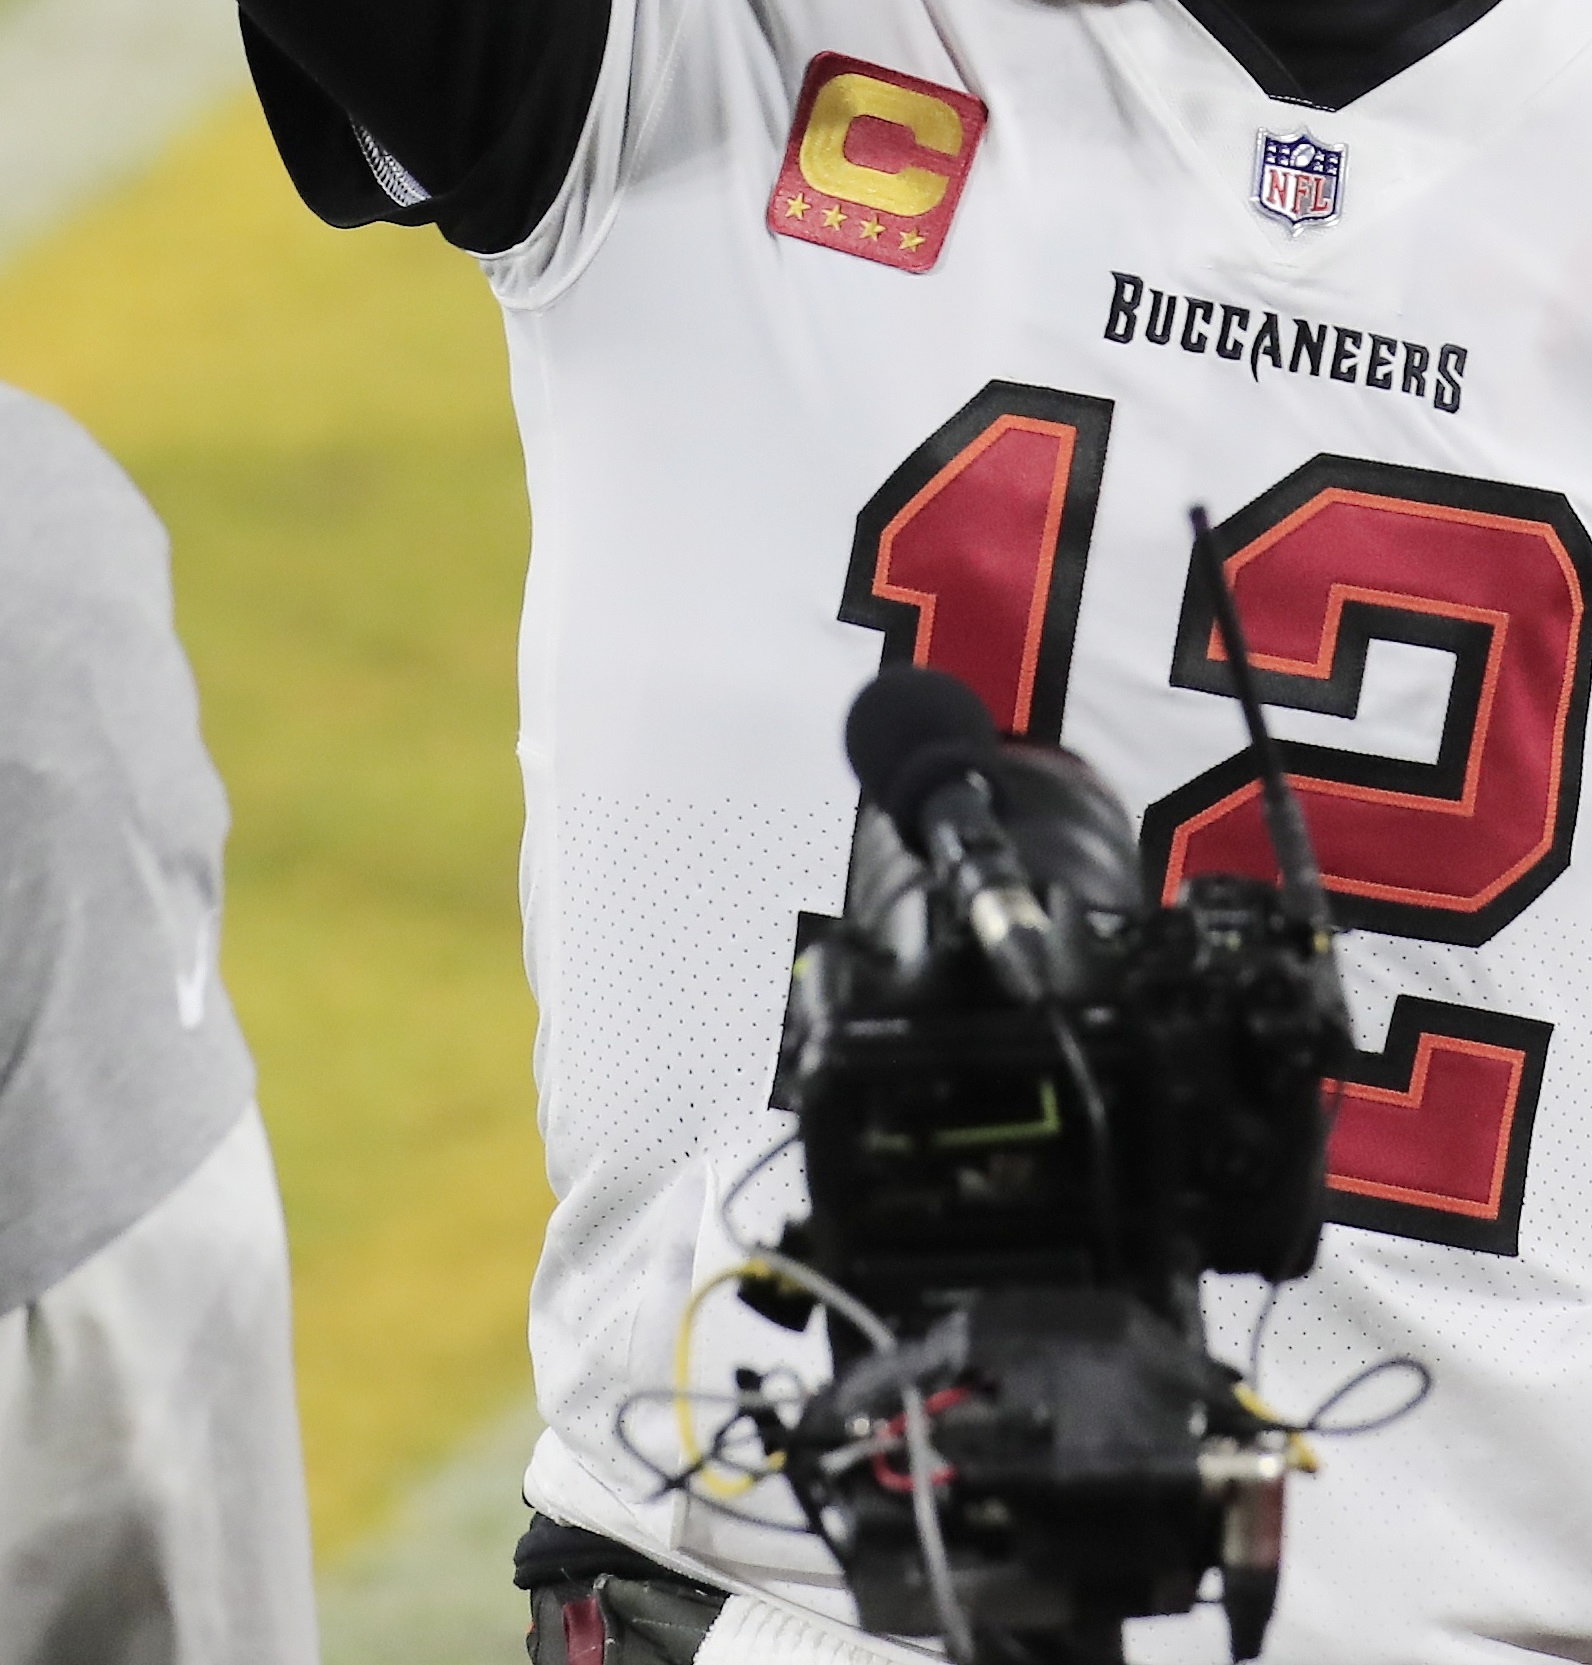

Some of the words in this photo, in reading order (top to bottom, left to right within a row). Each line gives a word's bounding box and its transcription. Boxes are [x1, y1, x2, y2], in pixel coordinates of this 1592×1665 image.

[799, 72, 964, 220] C
[1266, 168, 1329, 214] NFL
[1102, 269, 1468, 414] BUCCANEERS
